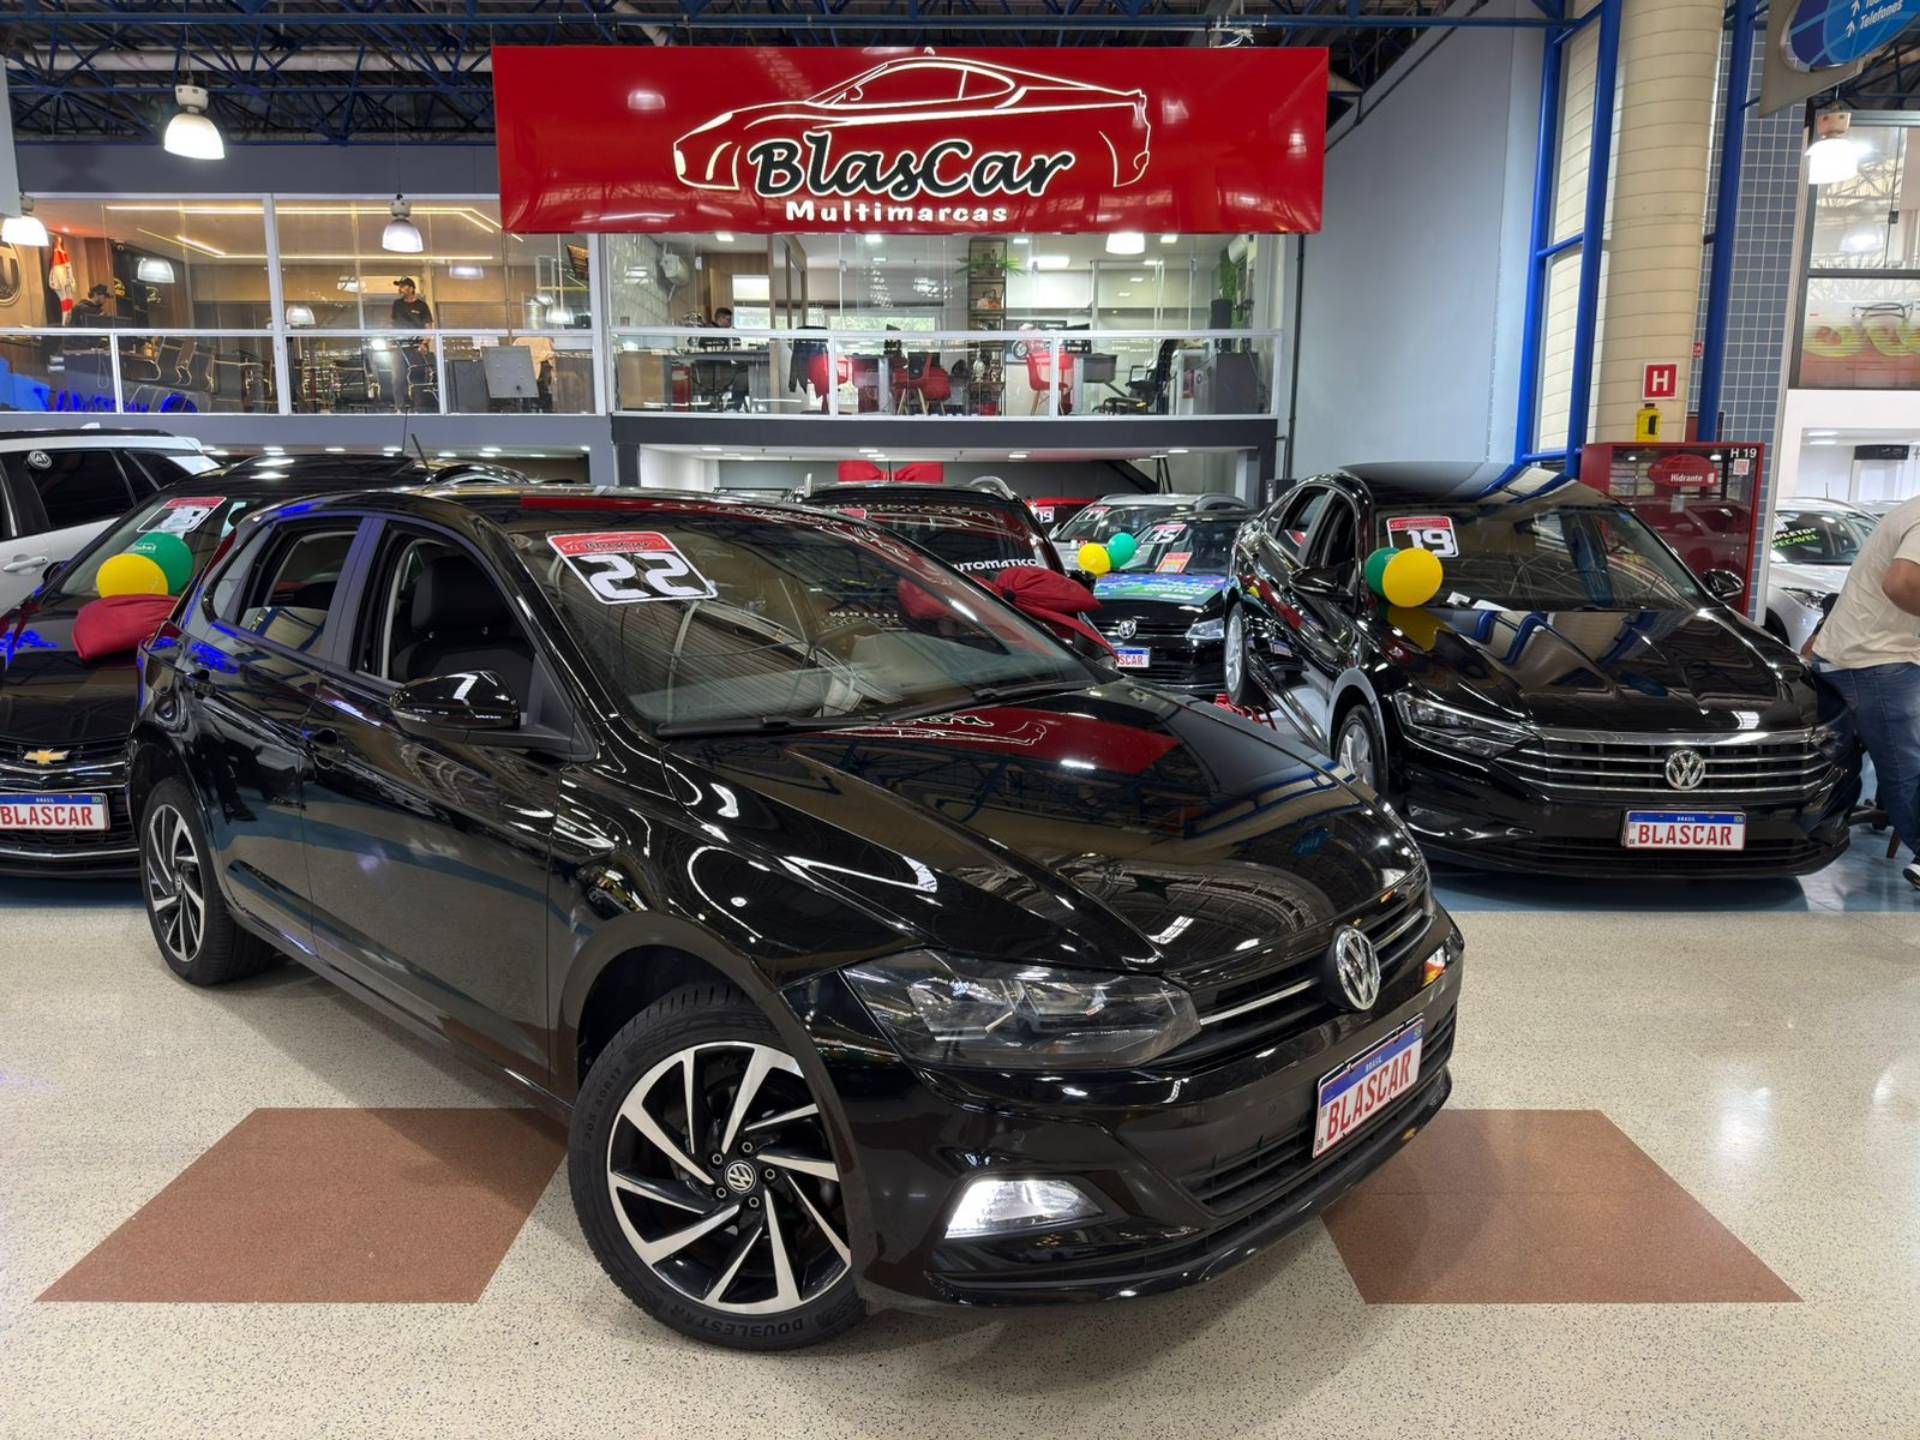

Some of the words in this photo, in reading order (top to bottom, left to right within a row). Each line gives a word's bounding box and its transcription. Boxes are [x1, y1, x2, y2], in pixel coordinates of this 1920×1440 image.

[748, 131, 1076, 201] BlasCar
[785, 202, 1008, 222] Multimarcas
[1651, 370, 1669, 392] H
[1730, 448, 1741, 458] H
[1743, 448, 1757, 458] 19
[1670, 473, 1703, 482] Hidrante
[1407, 529, 1455, 556] 19
[578, 552, 706, 599] 22
[953, 558, 1039, 573] UTOMATICO
[1117, 655, 1144, 666] SCAR
[0, 806, 94, 826] BLASCAR
[1638, 825, 1732, 846] BLASCAR
[1327, 1049, 1412, 1142] BLASCAR
